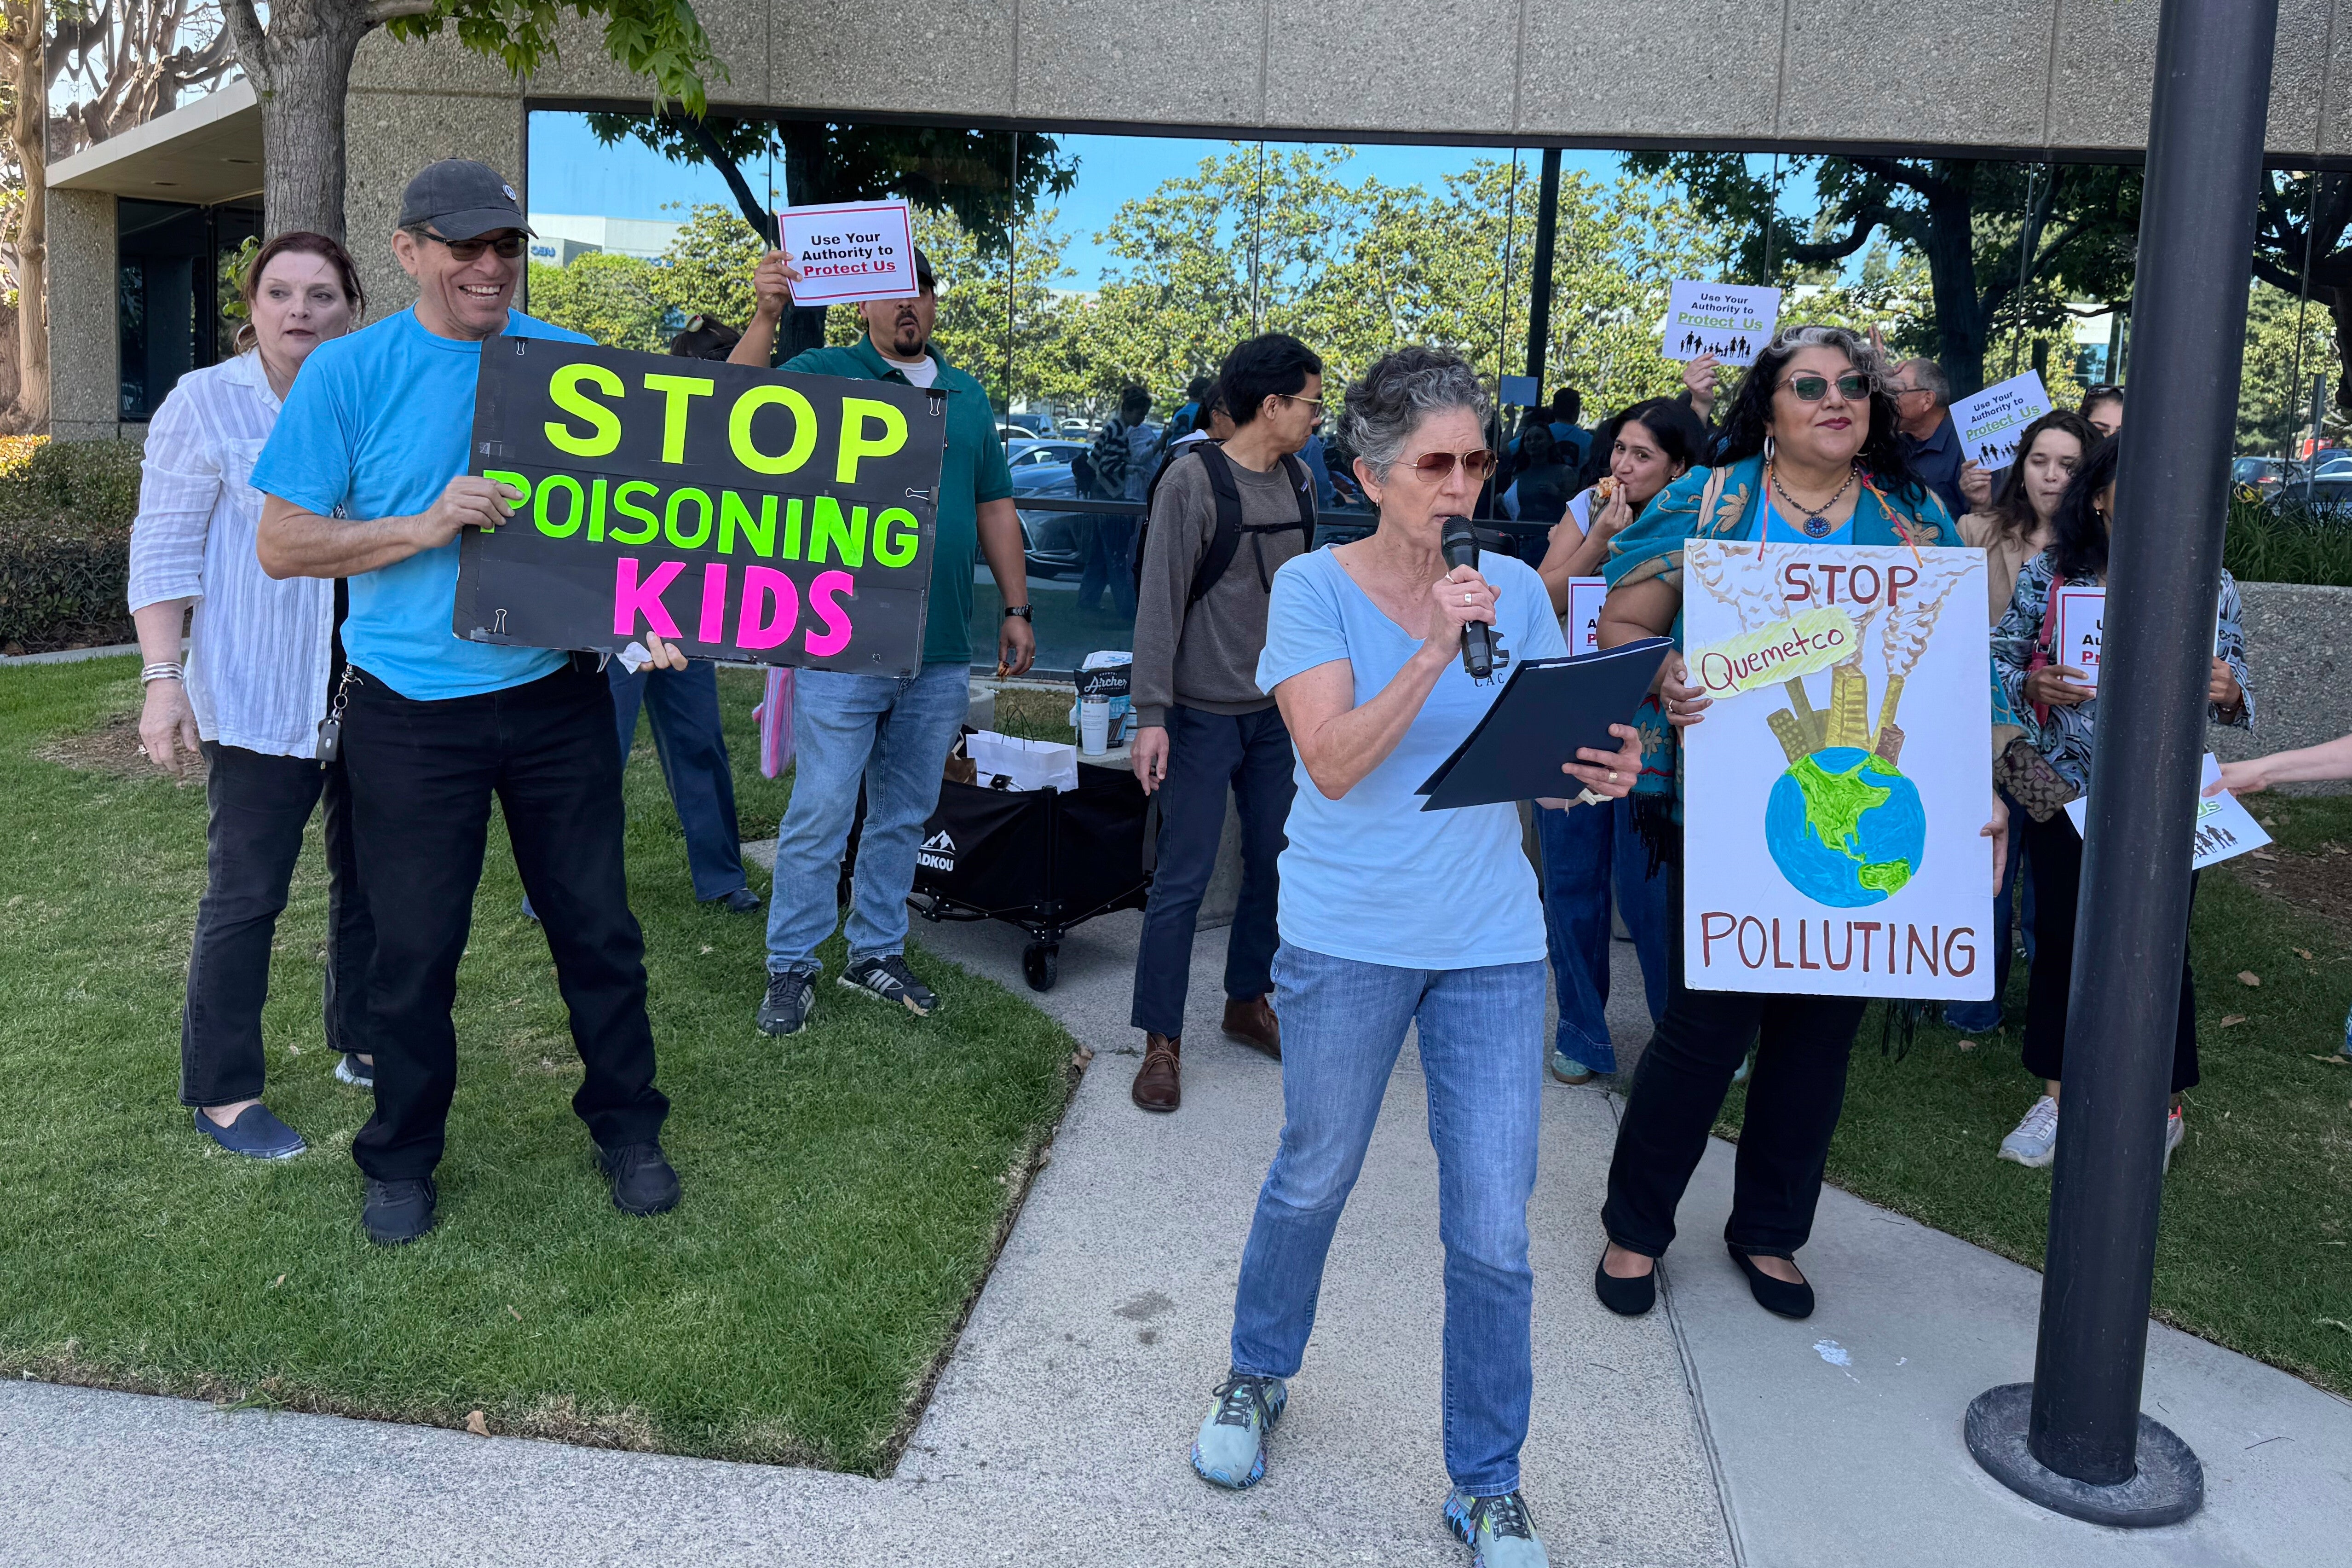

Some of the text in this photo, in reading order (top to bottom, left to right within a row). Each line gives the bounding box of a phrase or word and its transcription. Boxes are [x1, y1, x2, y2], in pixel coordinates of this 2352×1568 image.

[811, 233, 881, 246] Use Your
[802, 245, 894, 261] Authority to
[804, 260, 896, 276] Protect Us
[1691, 302, 1740, 315] Authority
[1701, 293, 1748, 305] Use Your
[1678, 311, 1763, 329] Protect Us
[1971, 398, 2024, 423] Authority to
[1973, 391, 2013, 412] Use Your
[543, 363, 909, 484] STOP
[1965, 405, 2041, 440] Protect Us
[1784, 563, 1919, 607] STOP
[613, 557, 855, 657] KIDS
[1701, 626, 1845, 692] Quemetco
[1084, 676, 1127, 693] Archer
[1700, 911, 1976, 978] POLLUTING
